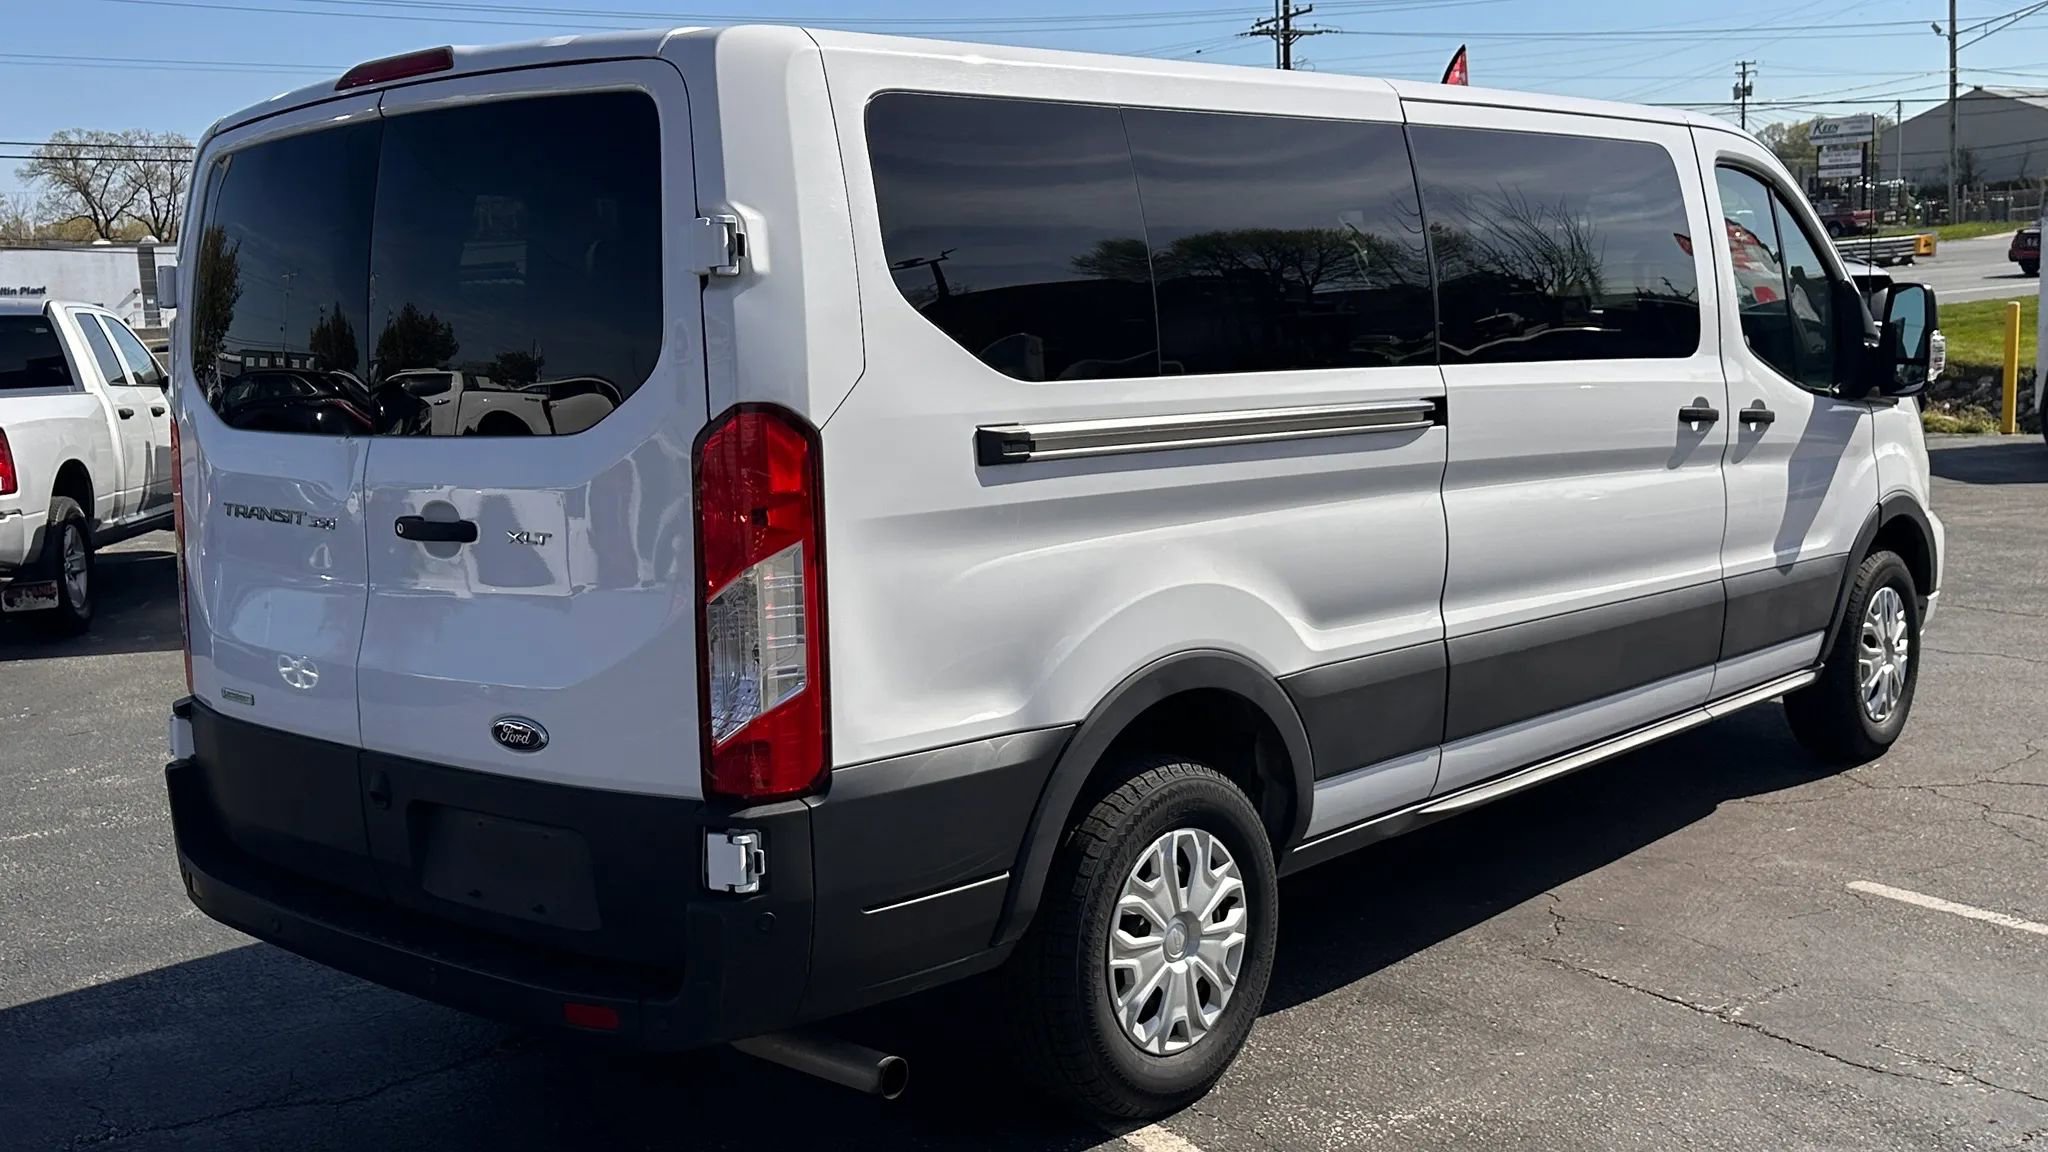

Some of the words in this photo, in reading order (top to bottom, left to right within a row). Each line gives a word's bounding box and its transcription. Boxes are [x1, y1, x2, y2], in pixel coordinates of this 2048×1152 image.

[19, 286, 47, 296] Plant
[224, 502, 305, 525] TRANSIT
[507, 530, 552, 546] XLT
[500, 723, 530, 745] Ford
